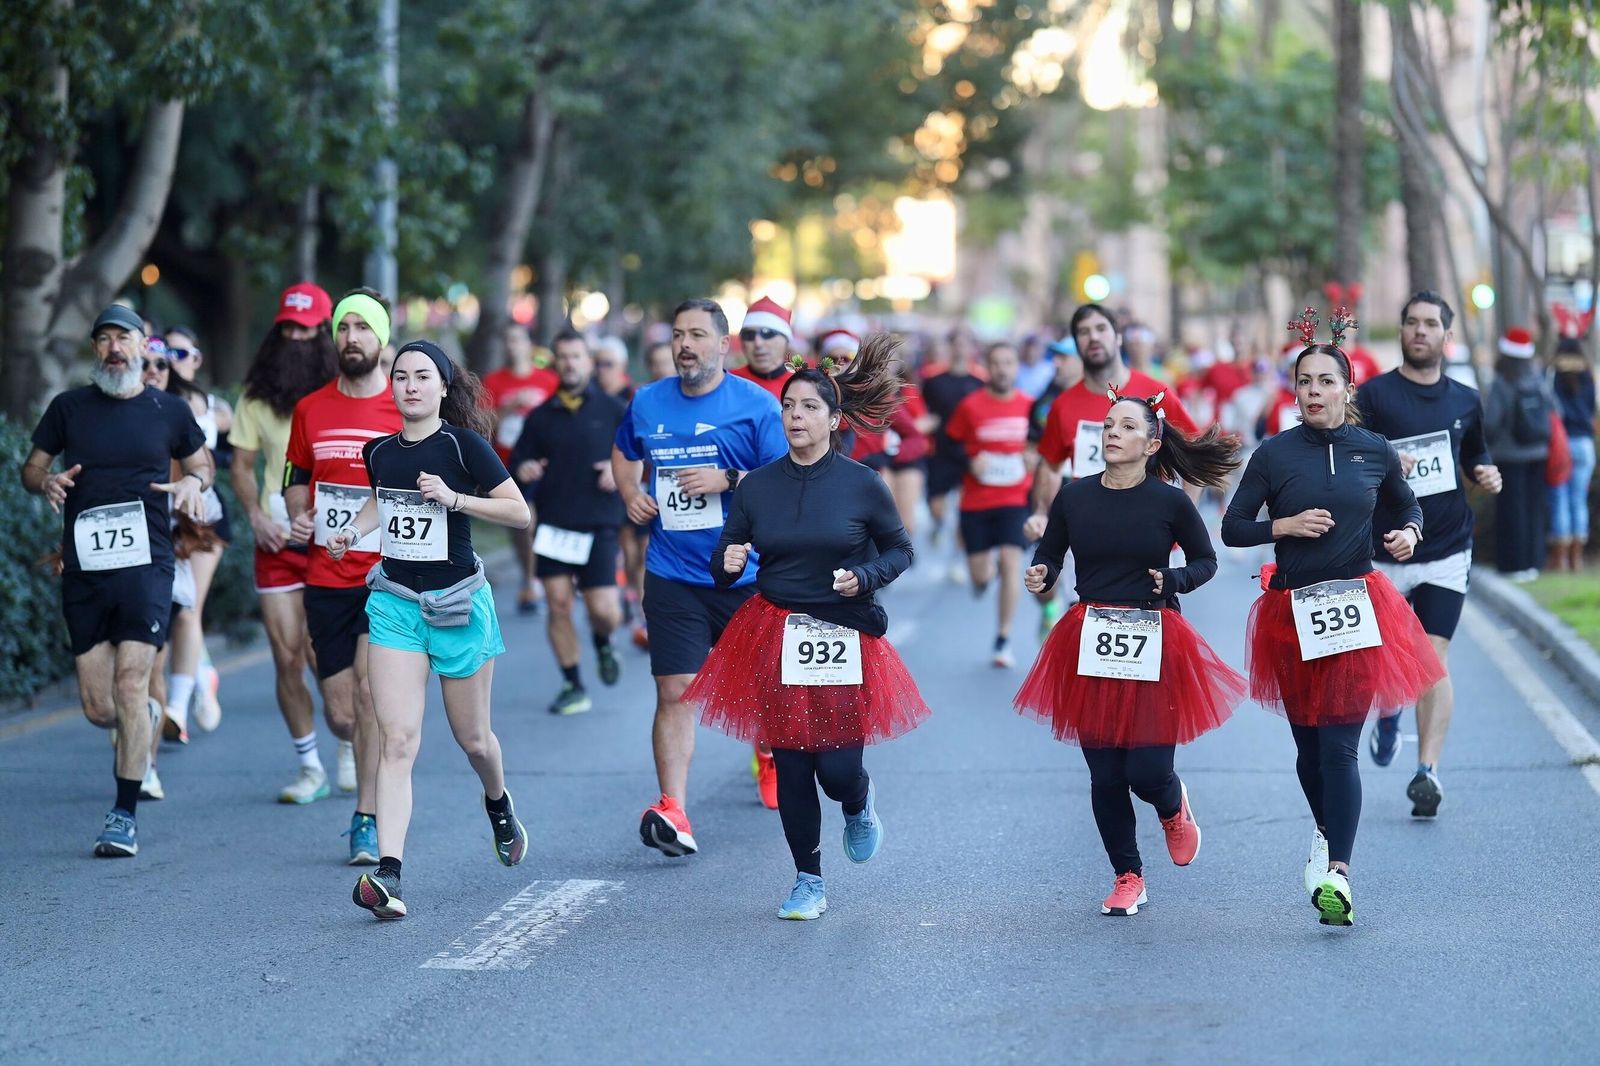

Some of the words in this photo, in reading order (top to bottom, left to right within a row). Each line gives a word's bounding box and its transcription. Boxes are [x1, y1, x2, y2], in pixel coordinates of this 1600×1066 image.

[686, 445, 718, 454] URBANA
[667, 491, 707, 511] 493
[327, 508, 358, 529] 82
[388, 516, 433, 540] 437
[90, 527, 134, 551] 175
[1310, 604, 1361, 636] 539
[798, 640, 847, 664] 932
[1095, 632, 1148, 659] 857
